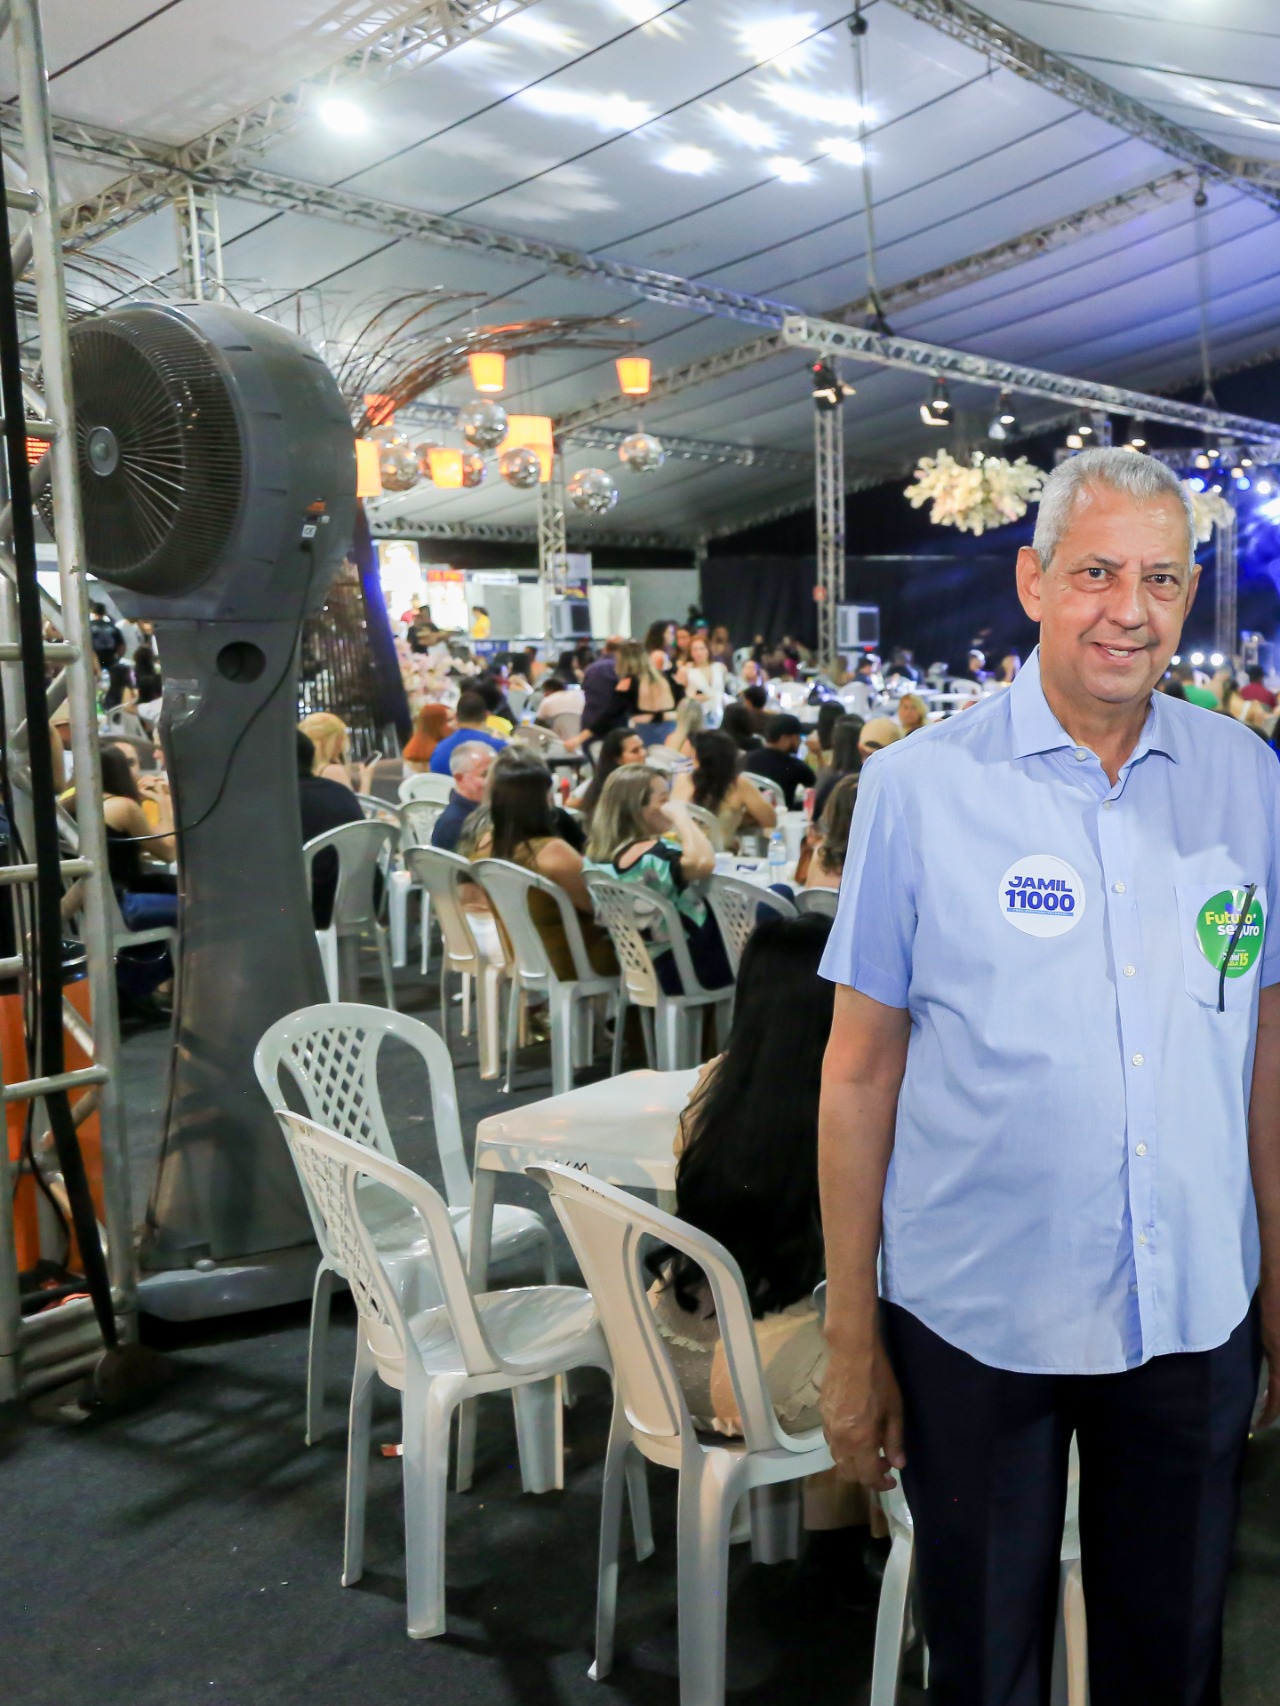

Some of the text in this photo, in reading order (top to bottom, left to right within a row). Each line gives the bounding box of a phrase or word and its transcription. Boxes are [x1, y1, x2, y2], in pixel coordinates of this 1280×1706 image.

[1008, 876, 1073, 892] JAMIL
[1004, 889, 1075, 912] 11000
[1205, 911, 1253, 925] Futuo
